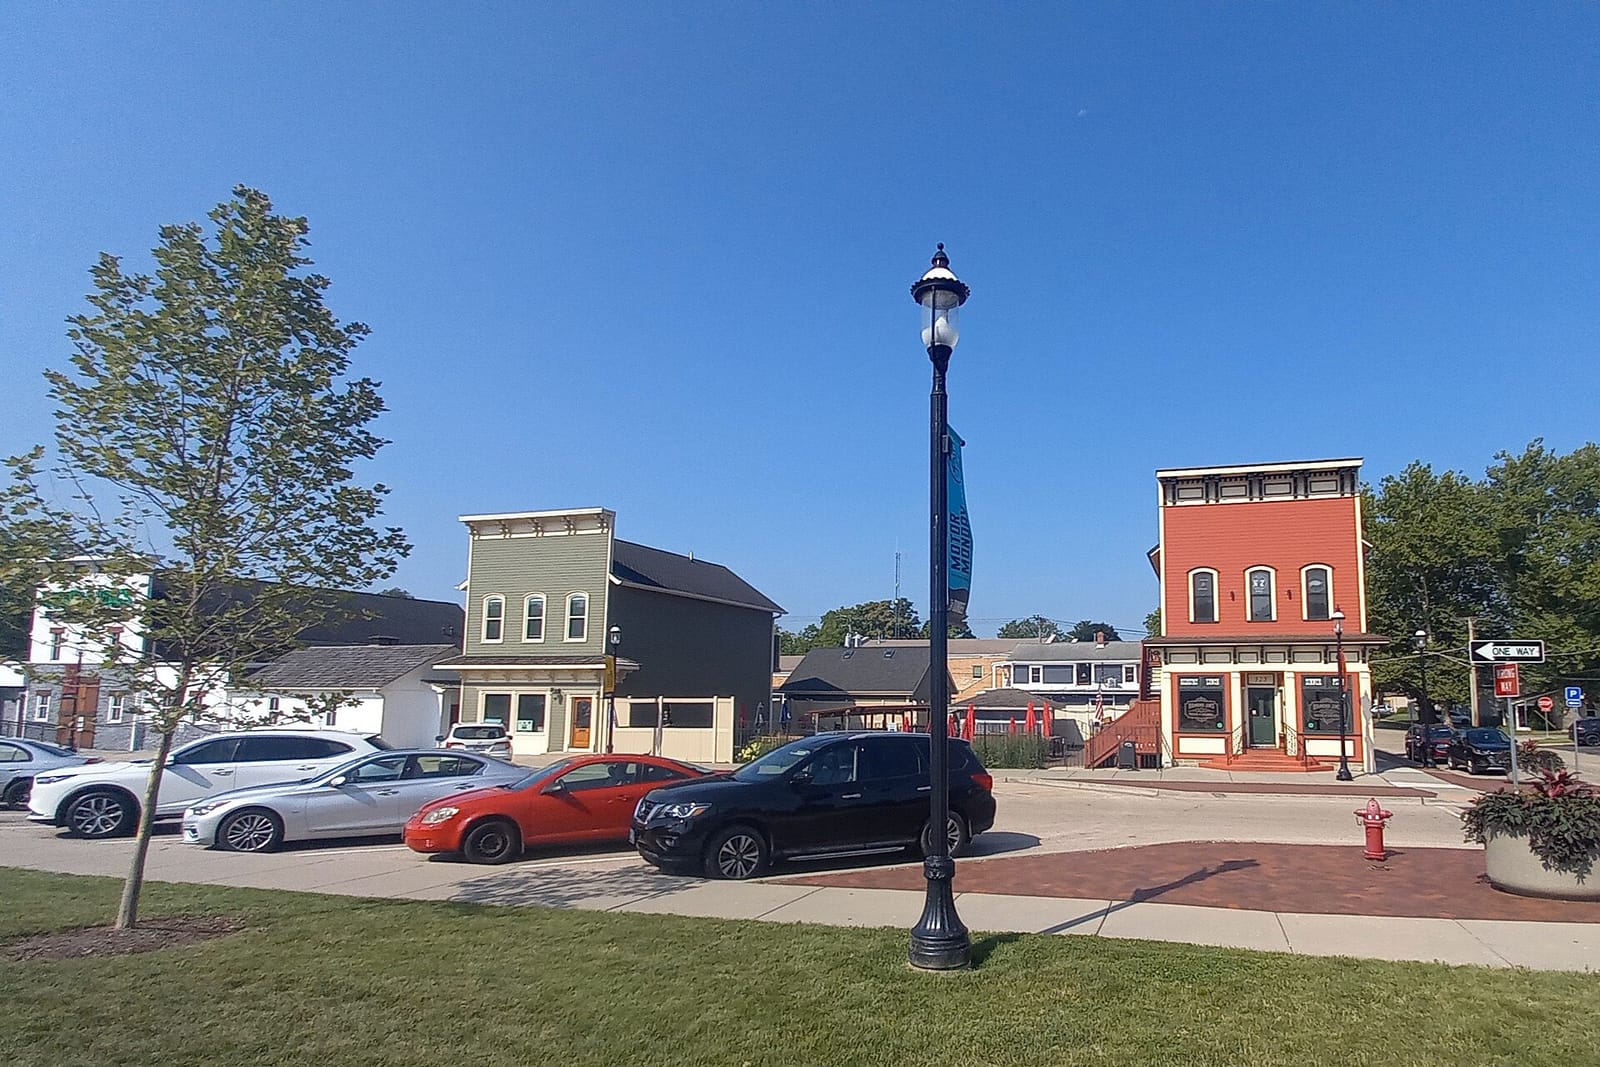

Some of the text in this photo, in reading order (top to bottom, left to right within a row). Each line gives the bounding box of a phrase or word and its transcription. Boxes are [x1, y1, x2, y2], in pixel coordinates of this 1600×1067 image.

[950, 512, 961, 571] MOTOR
[960, 505, 970, 574] MONDAY
[1492, 647, 1535, 656] ONE WAY
[1570, 690, 1578, 698] P
